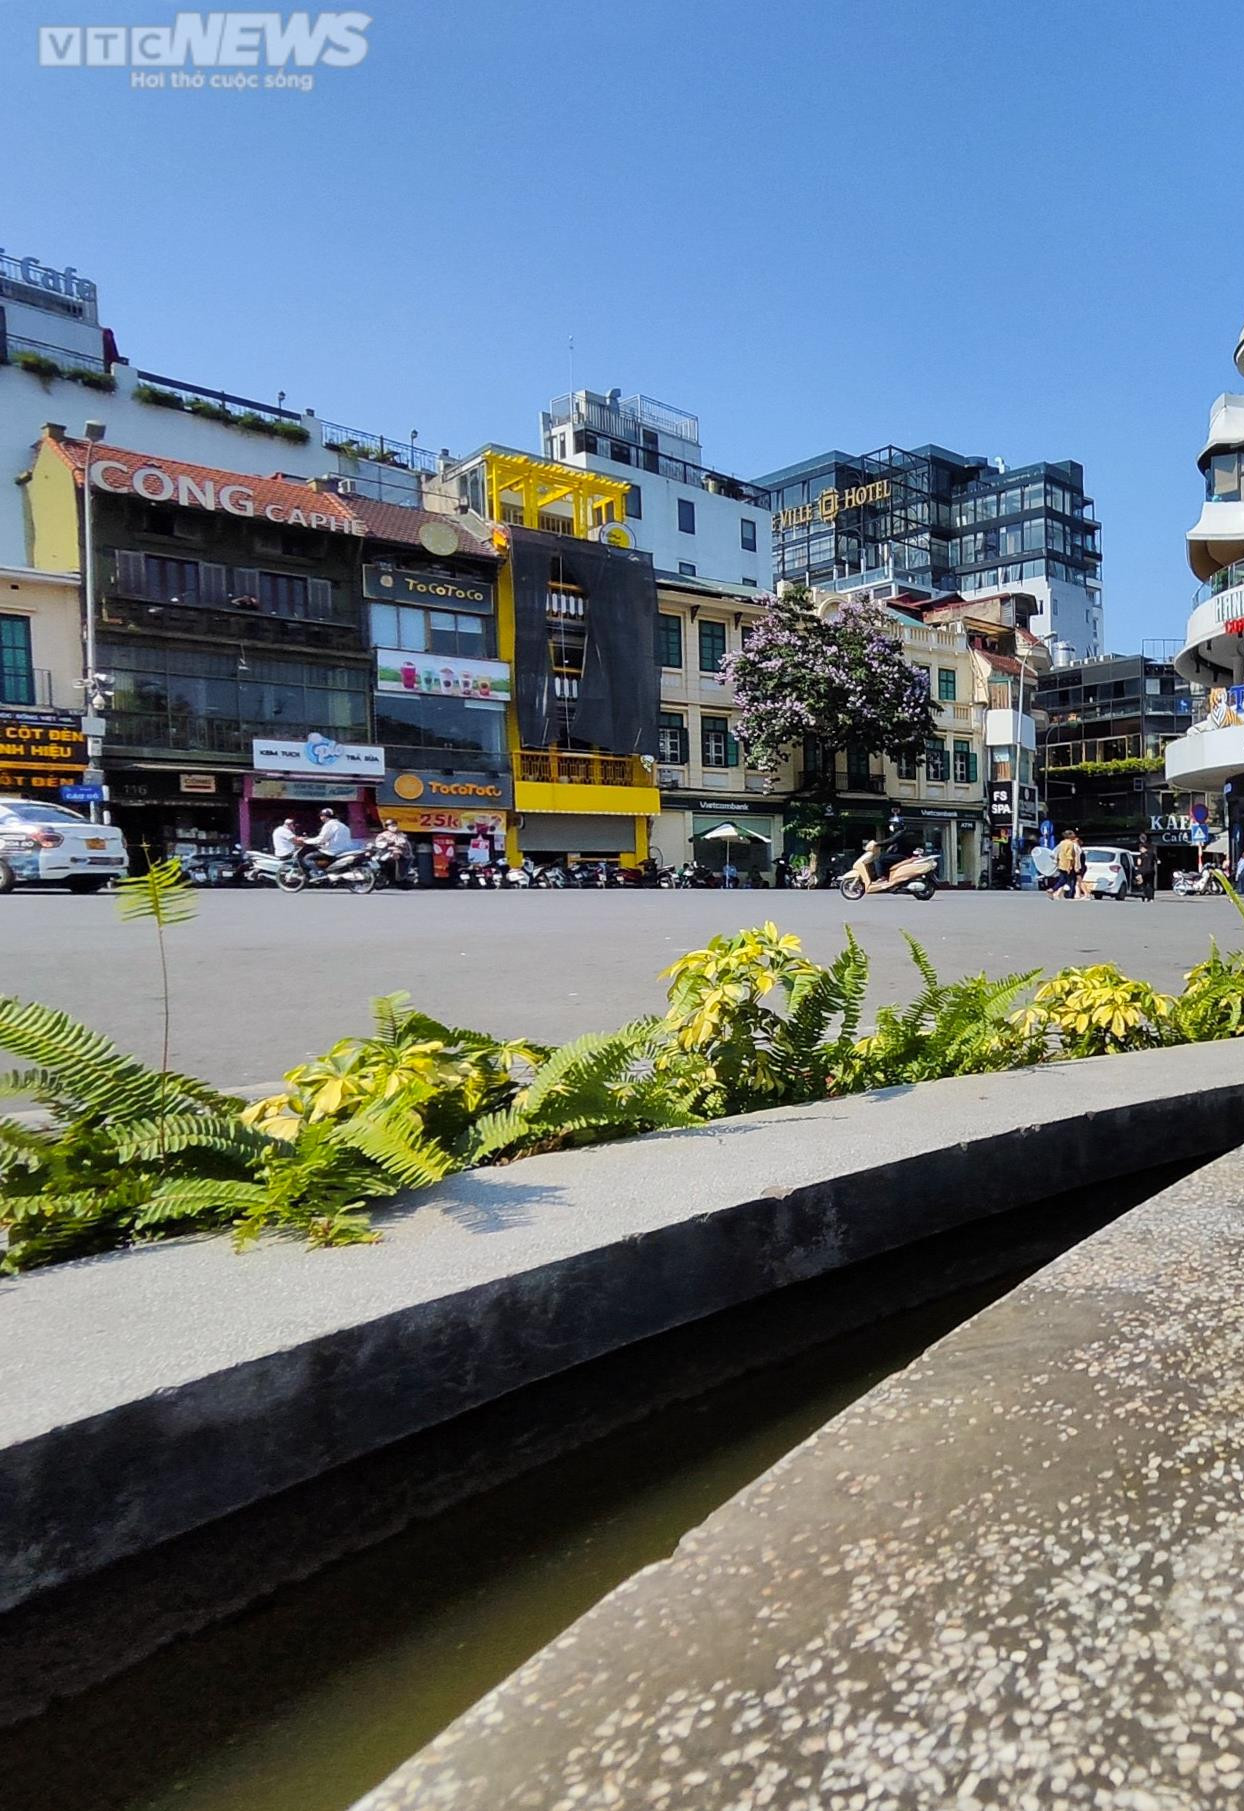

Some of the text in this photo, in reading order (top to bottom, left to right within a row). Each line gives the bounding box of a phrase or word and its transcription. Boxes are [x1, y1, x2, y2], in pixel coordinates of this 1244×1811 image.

[779, 503, 814, 528] VILLE
[844, 478, 891, 511] HOTEL
[993, 790, 1008, 801] FS
[699, 801, 750, 811] Vietcombank
[991, 803, 1011, 814] SPA
